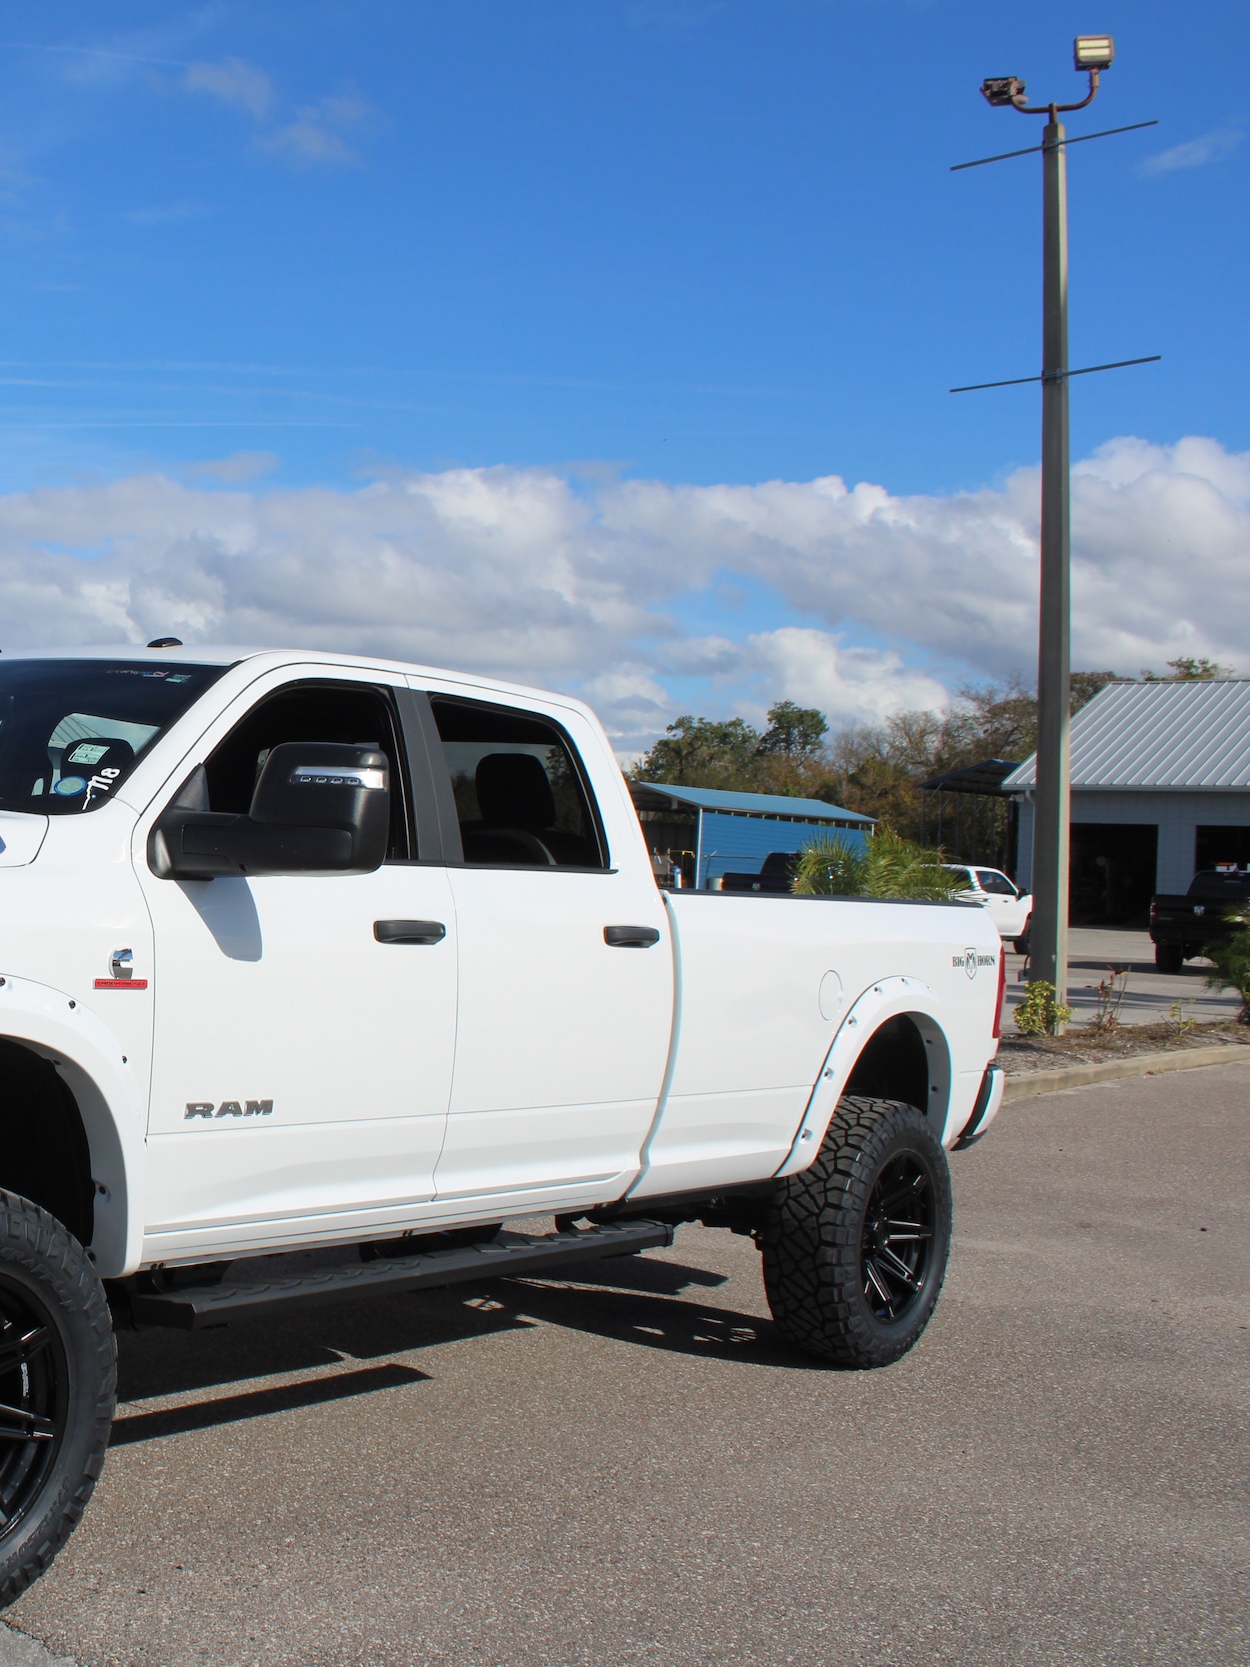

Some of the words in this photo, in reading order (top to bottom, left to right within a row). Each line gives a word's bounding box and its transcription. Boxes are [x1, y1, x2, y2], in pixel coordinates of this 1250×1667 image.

[951, 955, 965, 967] BIG
[976, 954, 996, 967] HORN
[183, 1099, 274, 1119] RAM
